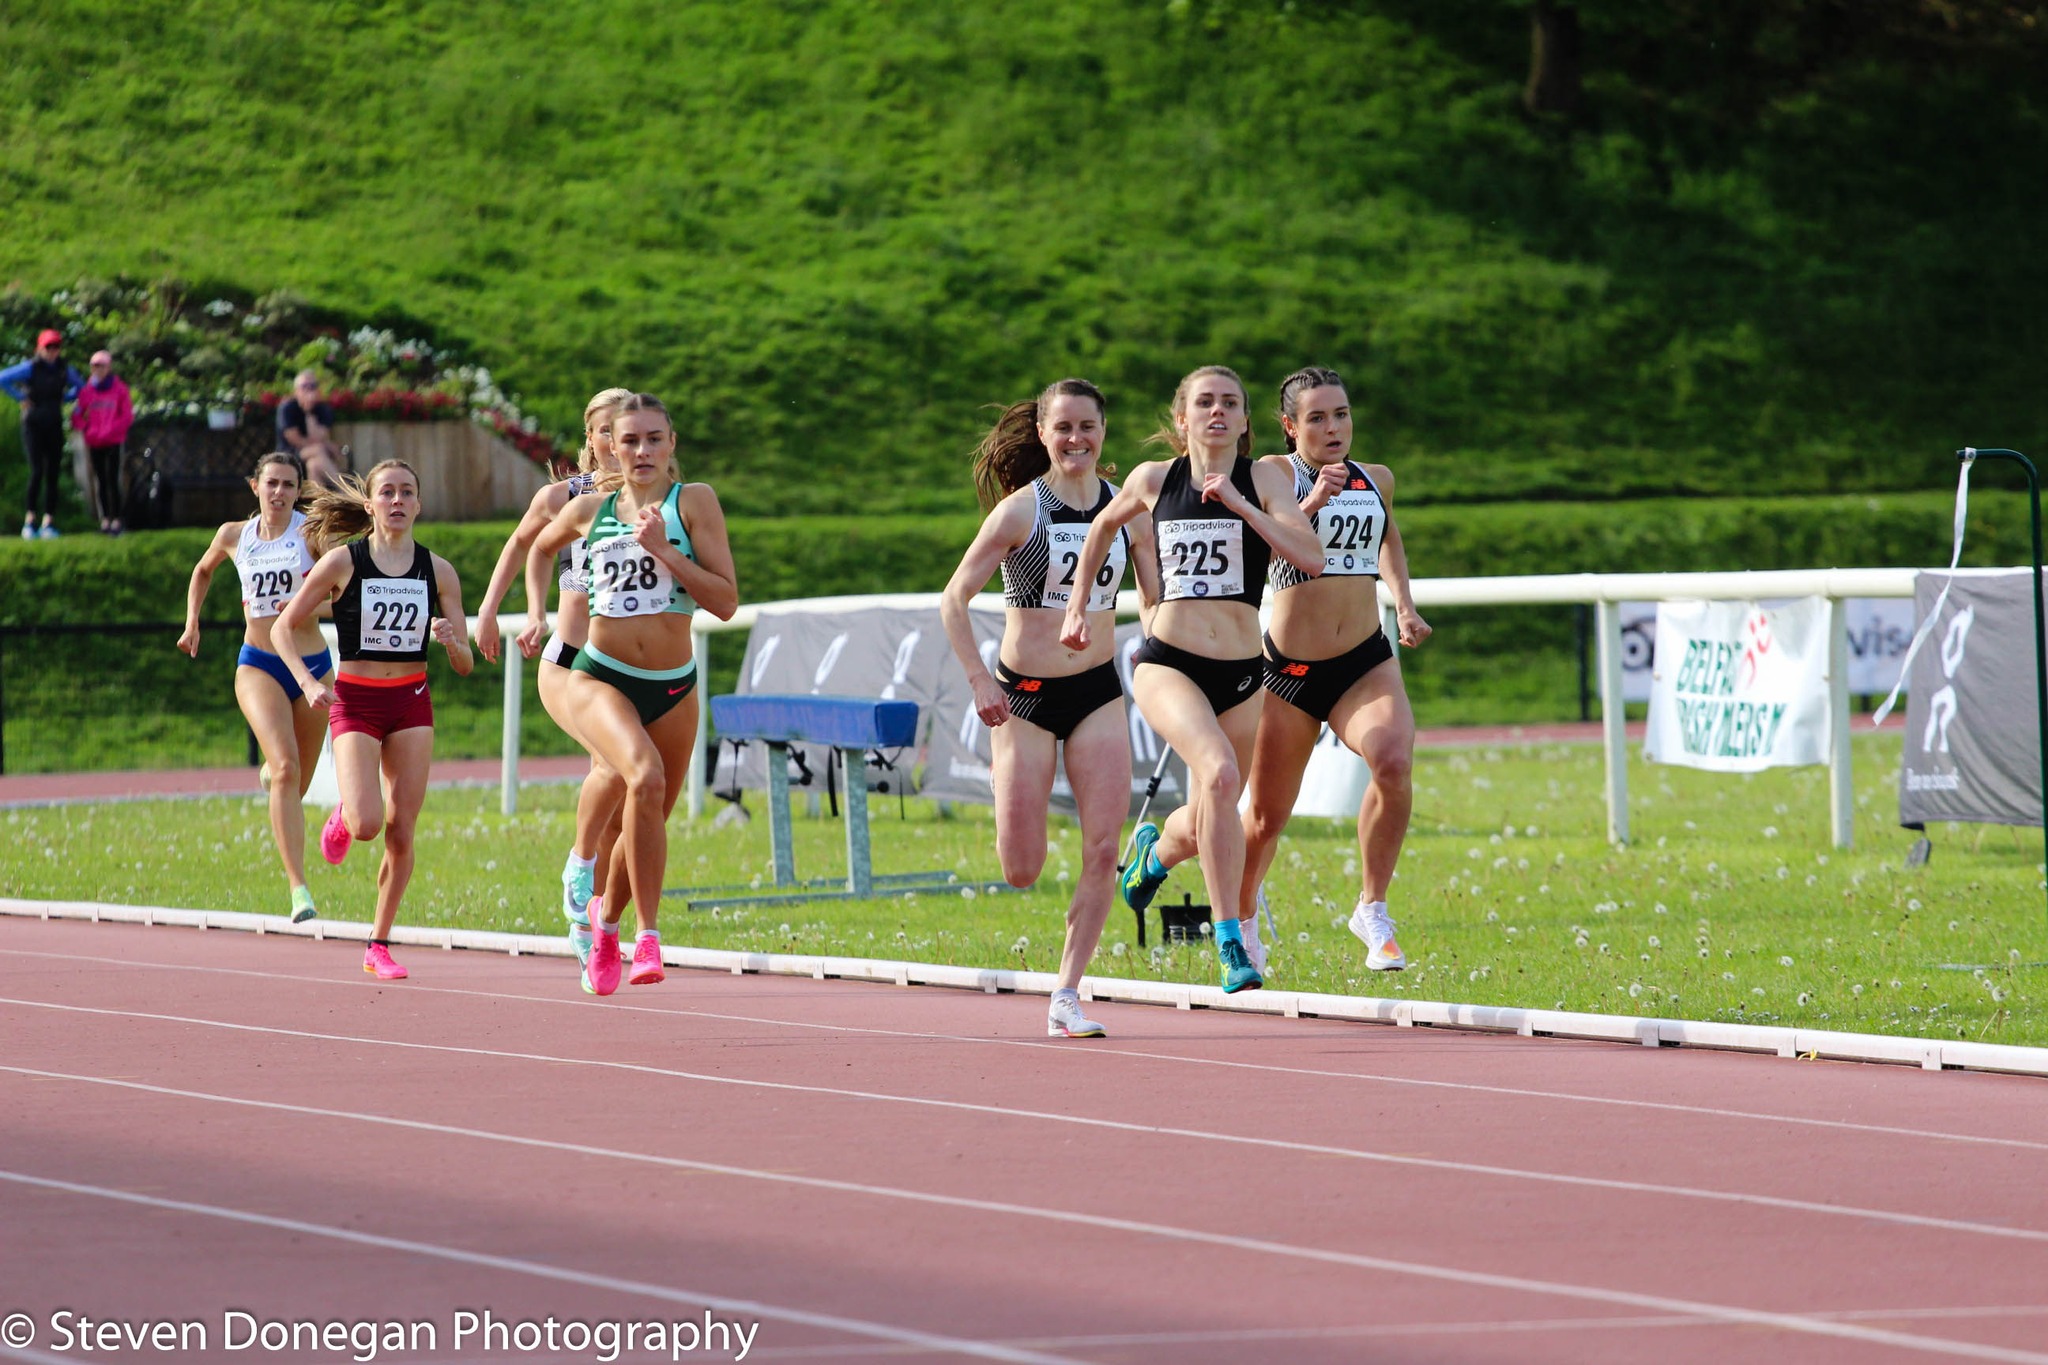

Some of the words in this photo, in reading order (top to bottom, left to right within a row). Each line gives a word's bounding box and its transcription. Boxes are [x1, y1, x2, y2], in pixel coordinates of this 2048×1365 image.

[1183, 521, 1236, 532] Tripadvisor
[1326, 514, 1374, 550] 224
[1059, 551, 1114, 587] 26
[1171, 540, 1229, 576] 225
[252, 569, 293, 598] 229
[603, 556, 658, 593] 228
[383, 586, 423, 595] Tripadvisor
[1048, 591, 1068, 602] IMC
[372, 601, 419, 631] 222
[364, 636, 382, 645] IMC
